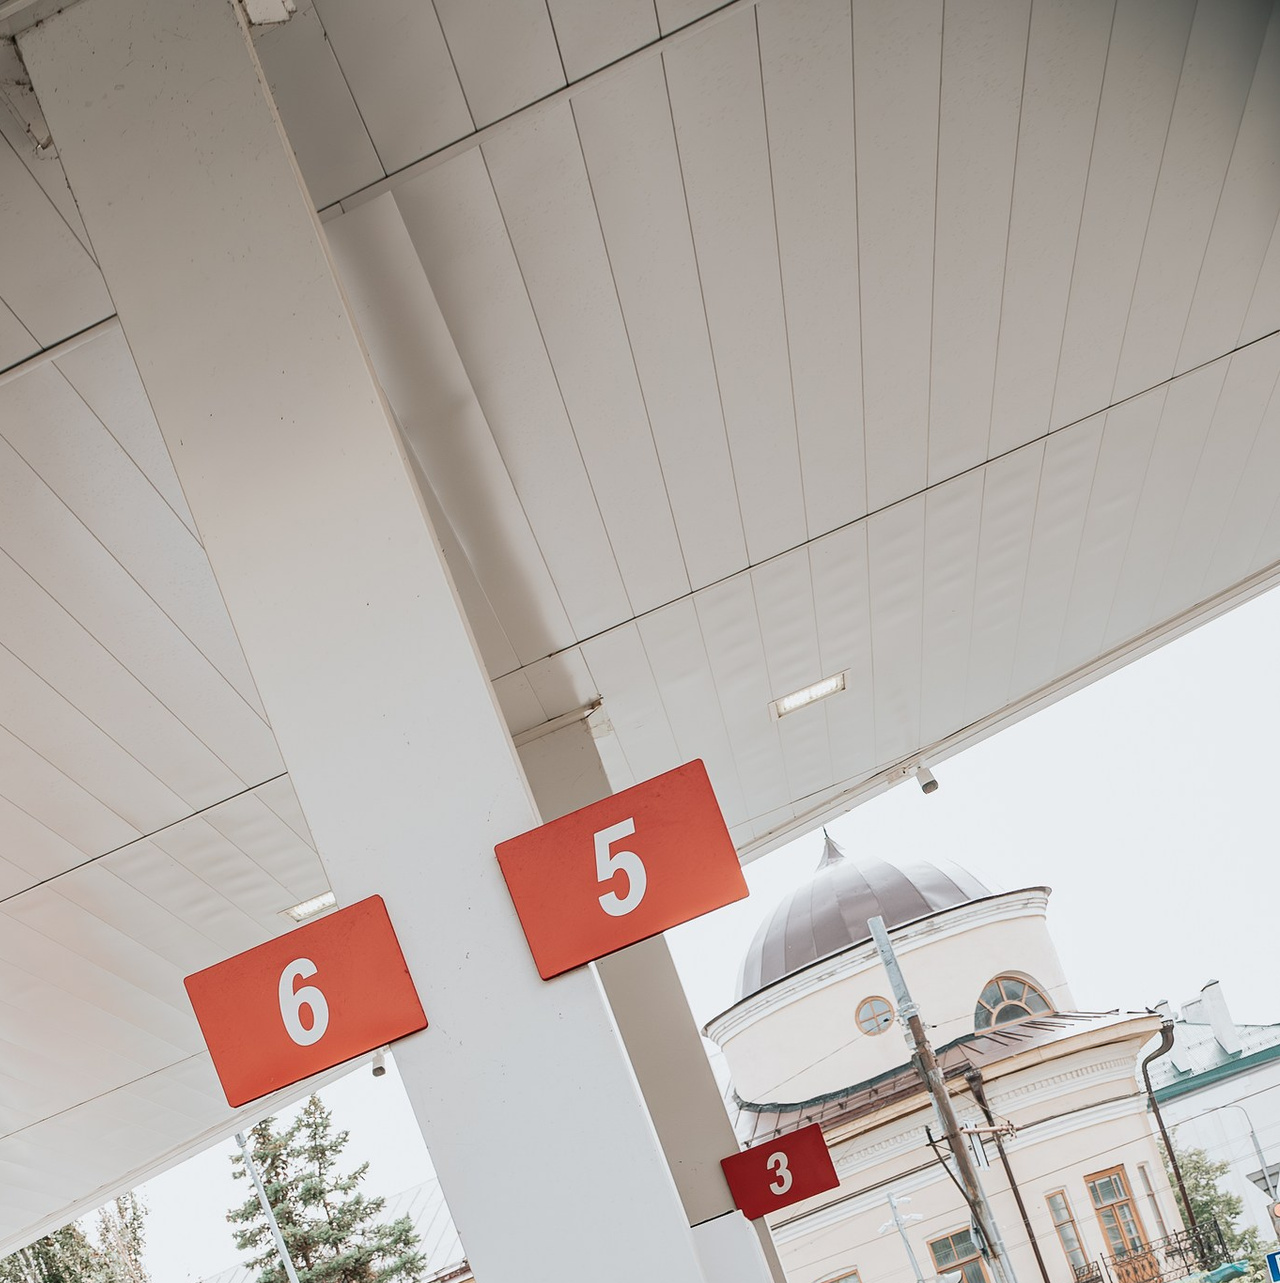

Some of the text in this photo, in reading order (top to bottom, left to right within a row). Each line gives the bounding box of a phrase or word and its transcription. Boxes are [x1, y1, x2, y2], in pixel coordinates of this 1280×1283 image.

[594, 817, 647, 917] 5
[277, 958, 329, 1046] 6
[767, 1152, 794, 1196] 3
